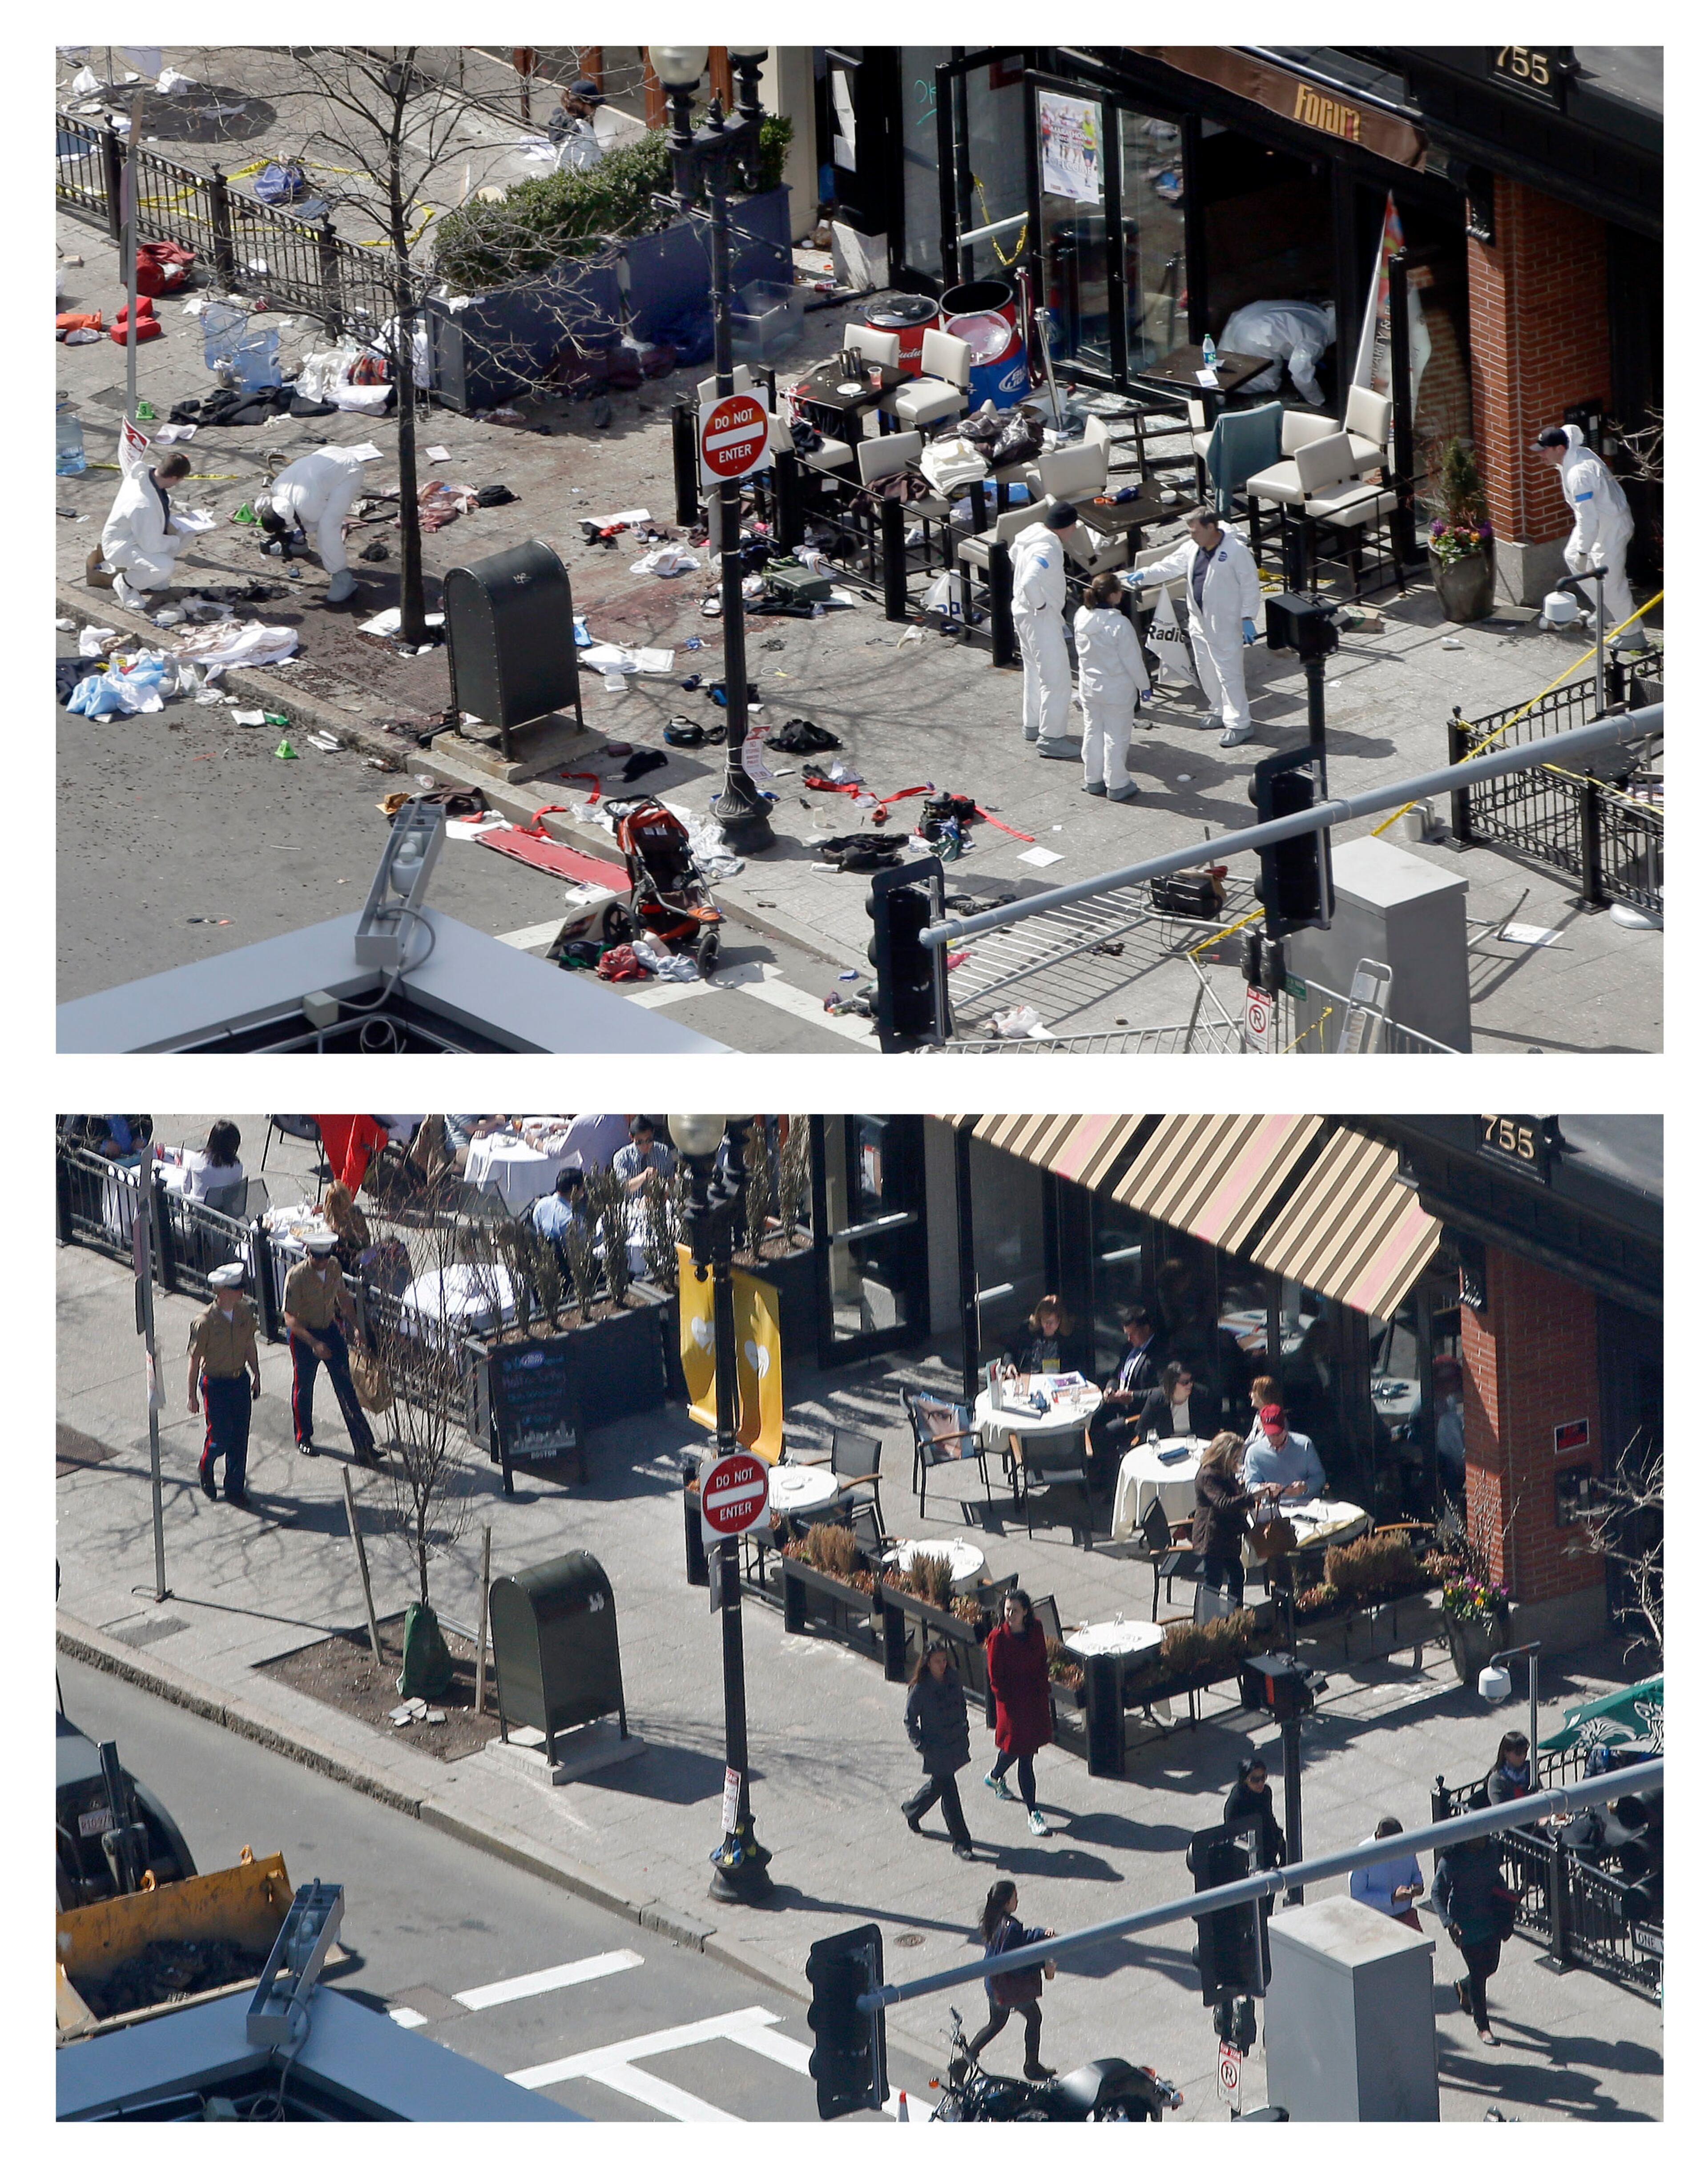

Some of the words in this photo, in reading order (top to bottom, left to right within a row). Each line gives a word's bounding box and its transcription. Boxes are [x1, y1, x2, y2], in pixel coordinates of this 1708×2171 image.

[1497, 46, 1549, 85] 755
[1294, 83, 1359, 141] Forum
[1048, 157, 1092, 175] WELCOME
[715, 416, 729, 430] DO
[733, 408, 753, 424] NOT
[719, 444, 752, 463] ENTER
[1481, 1114, 1535, 1160] 755
[716, 1474, 729, 1489] DO
[734, 1466, 753, 1484] NOT
[720, 1501, 752, 1522] ENTER
[1638, 1932, 1656, 1949] ONE
